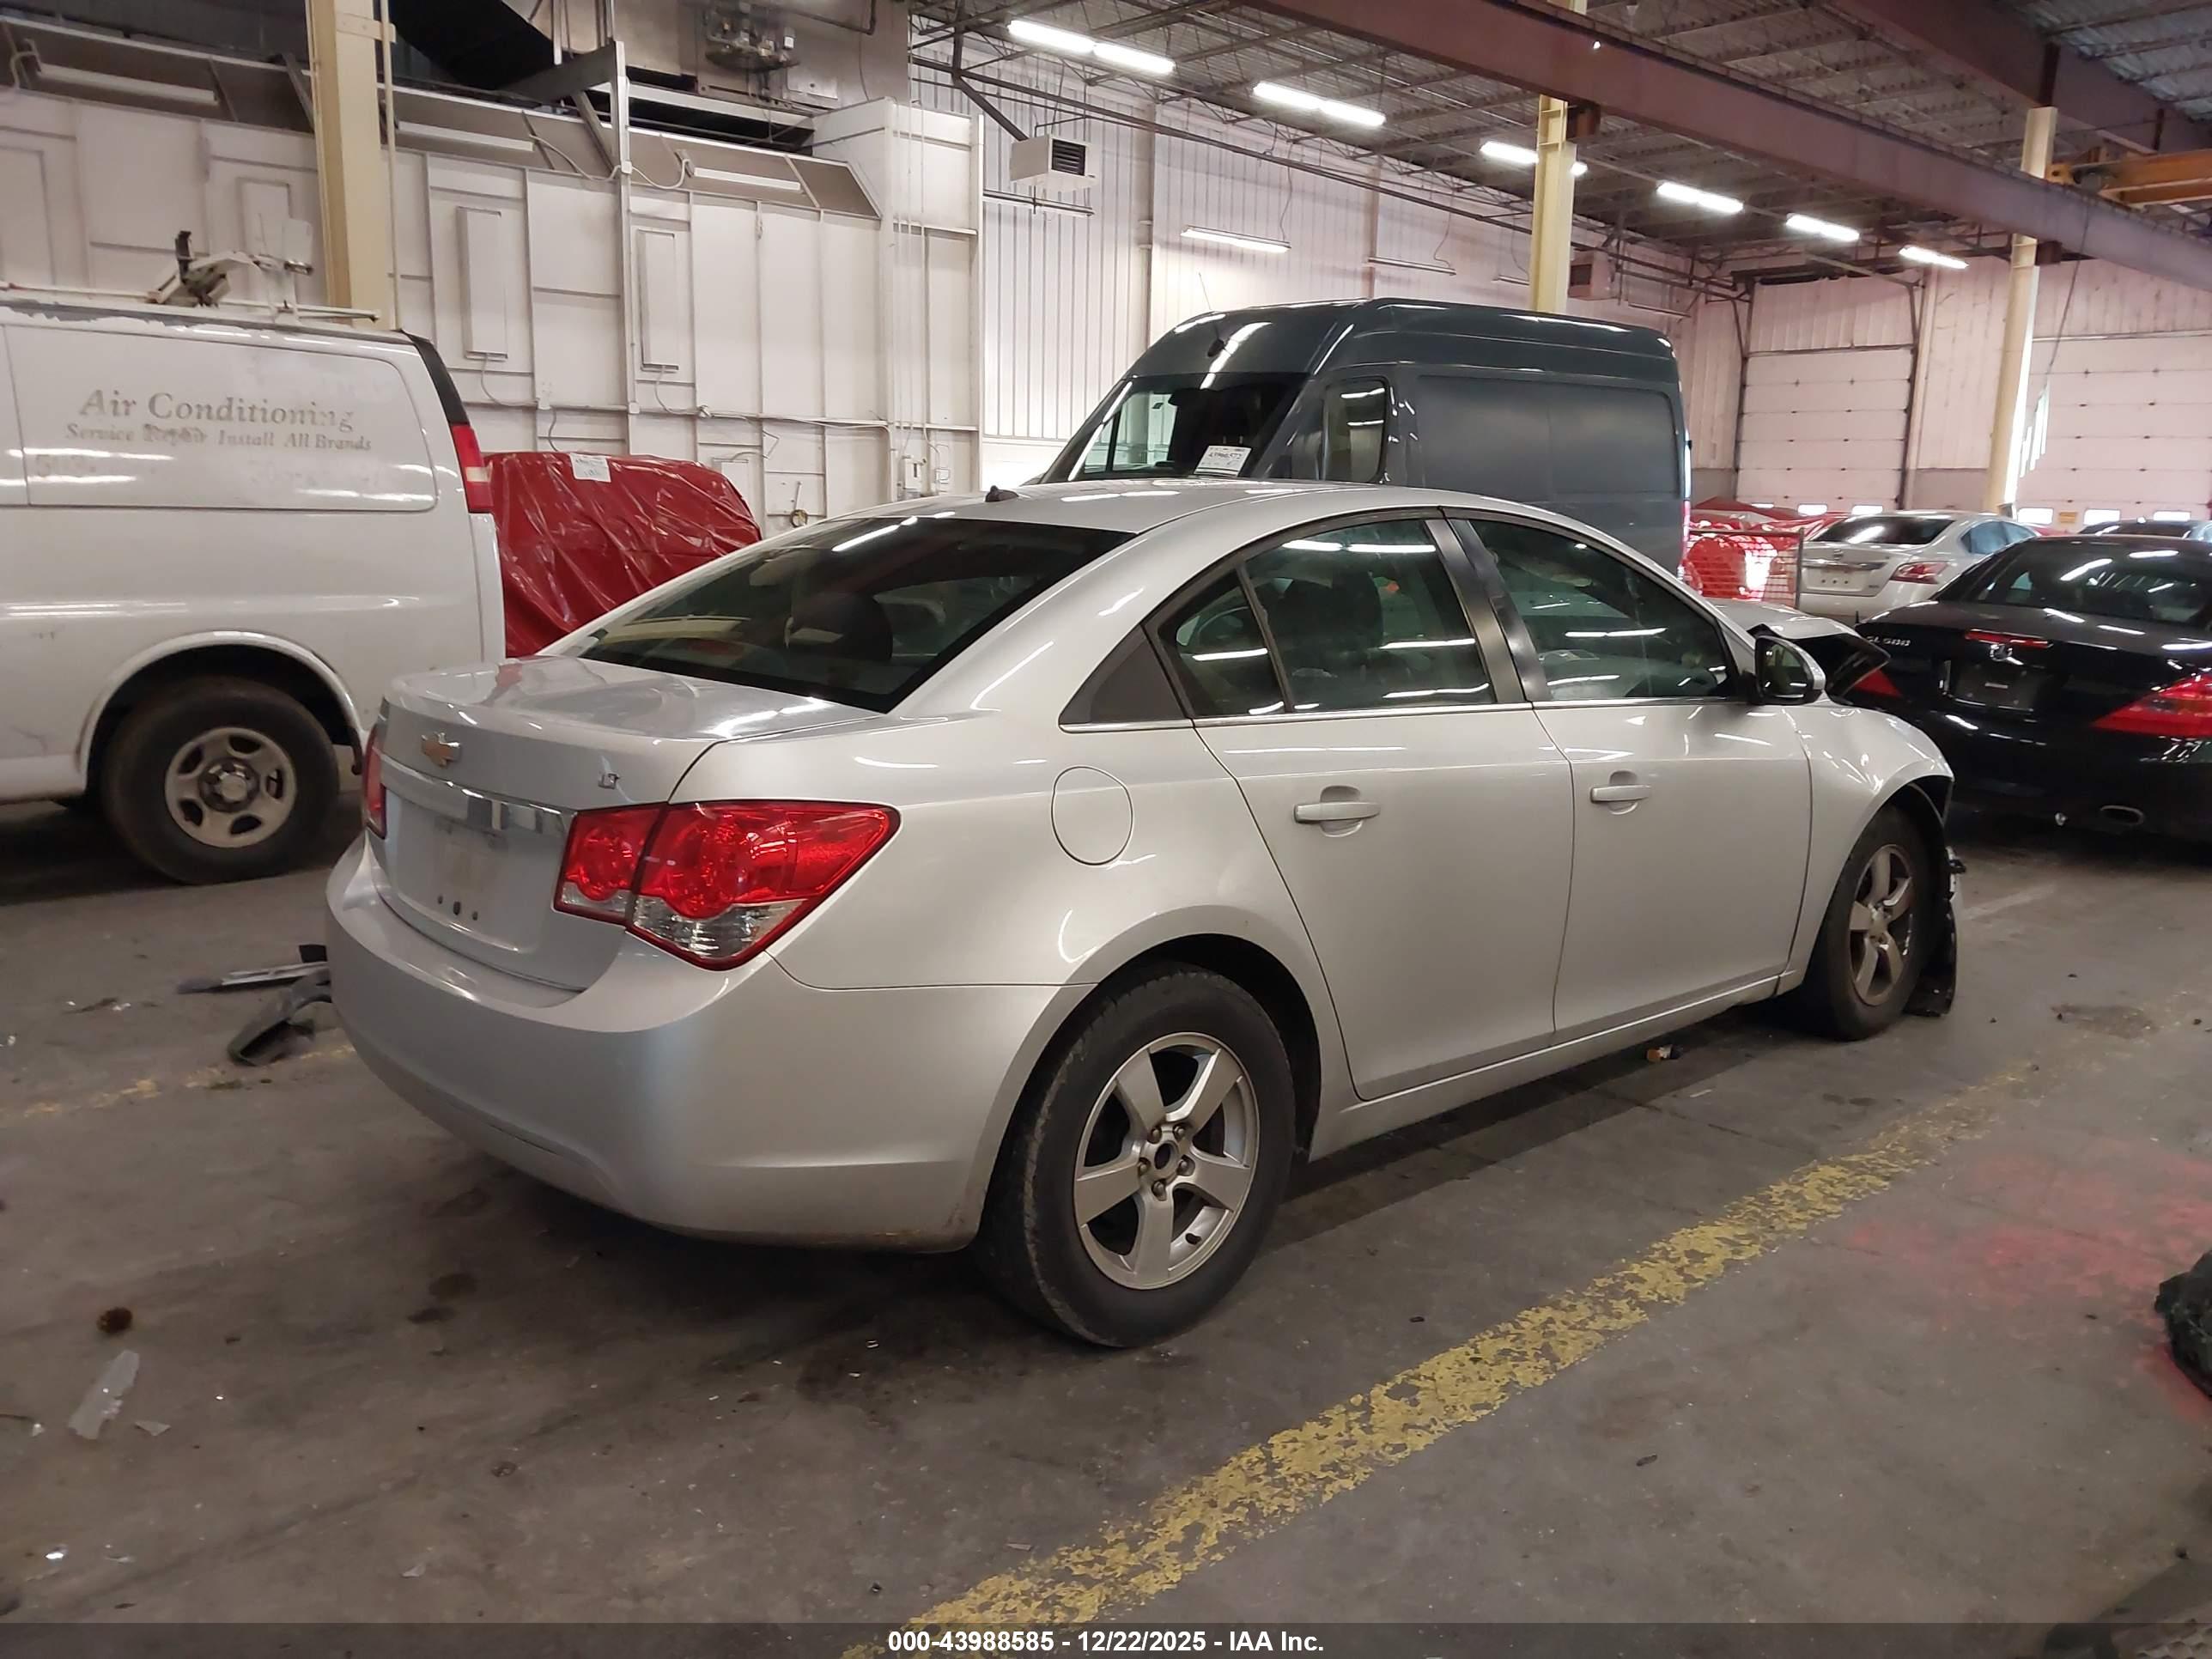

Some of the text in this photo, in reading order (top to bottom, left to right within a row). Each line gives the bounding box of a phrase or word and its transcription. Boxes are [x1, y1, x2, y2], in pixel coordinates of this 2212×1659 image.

[79, 389, 354, 434] Air Conditioning
[66, 422, 135, 443] Service
[218, 429, 275, 447] Install
[284, 432, 310, 448] All
[314, 433, 372, 451] Brands
